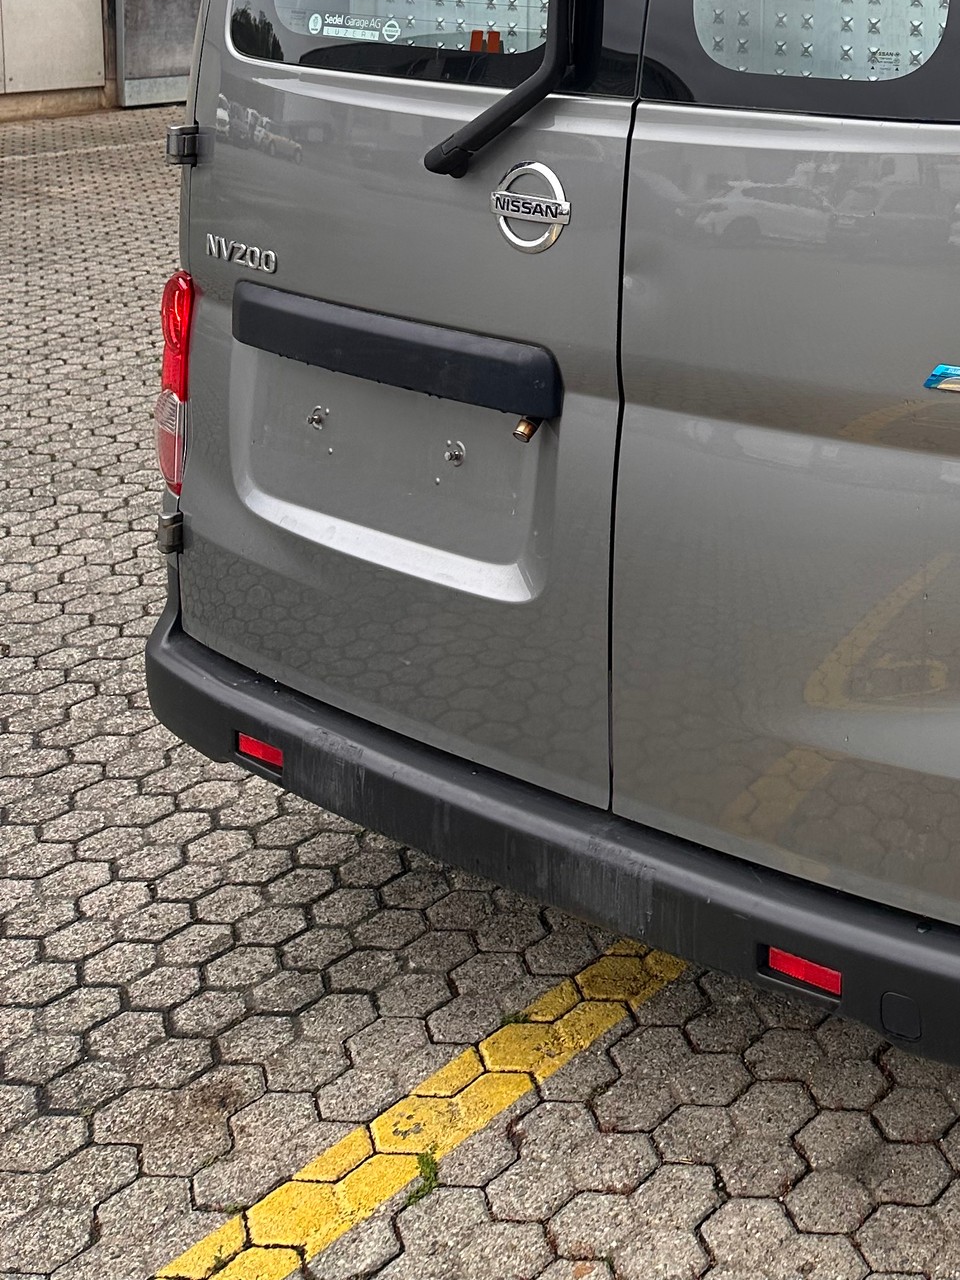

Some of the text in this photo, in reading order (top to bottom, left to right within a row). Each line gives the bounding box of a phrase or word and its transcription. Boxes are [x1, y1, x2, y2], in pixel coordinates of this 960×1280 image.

[324, 13, 381, 29] Sedel Garage AG
[326, 29, 376, 39] LUZERN
[495, 196, 558, 219] NISSAN
[206, 232, 277, 274] NV200
